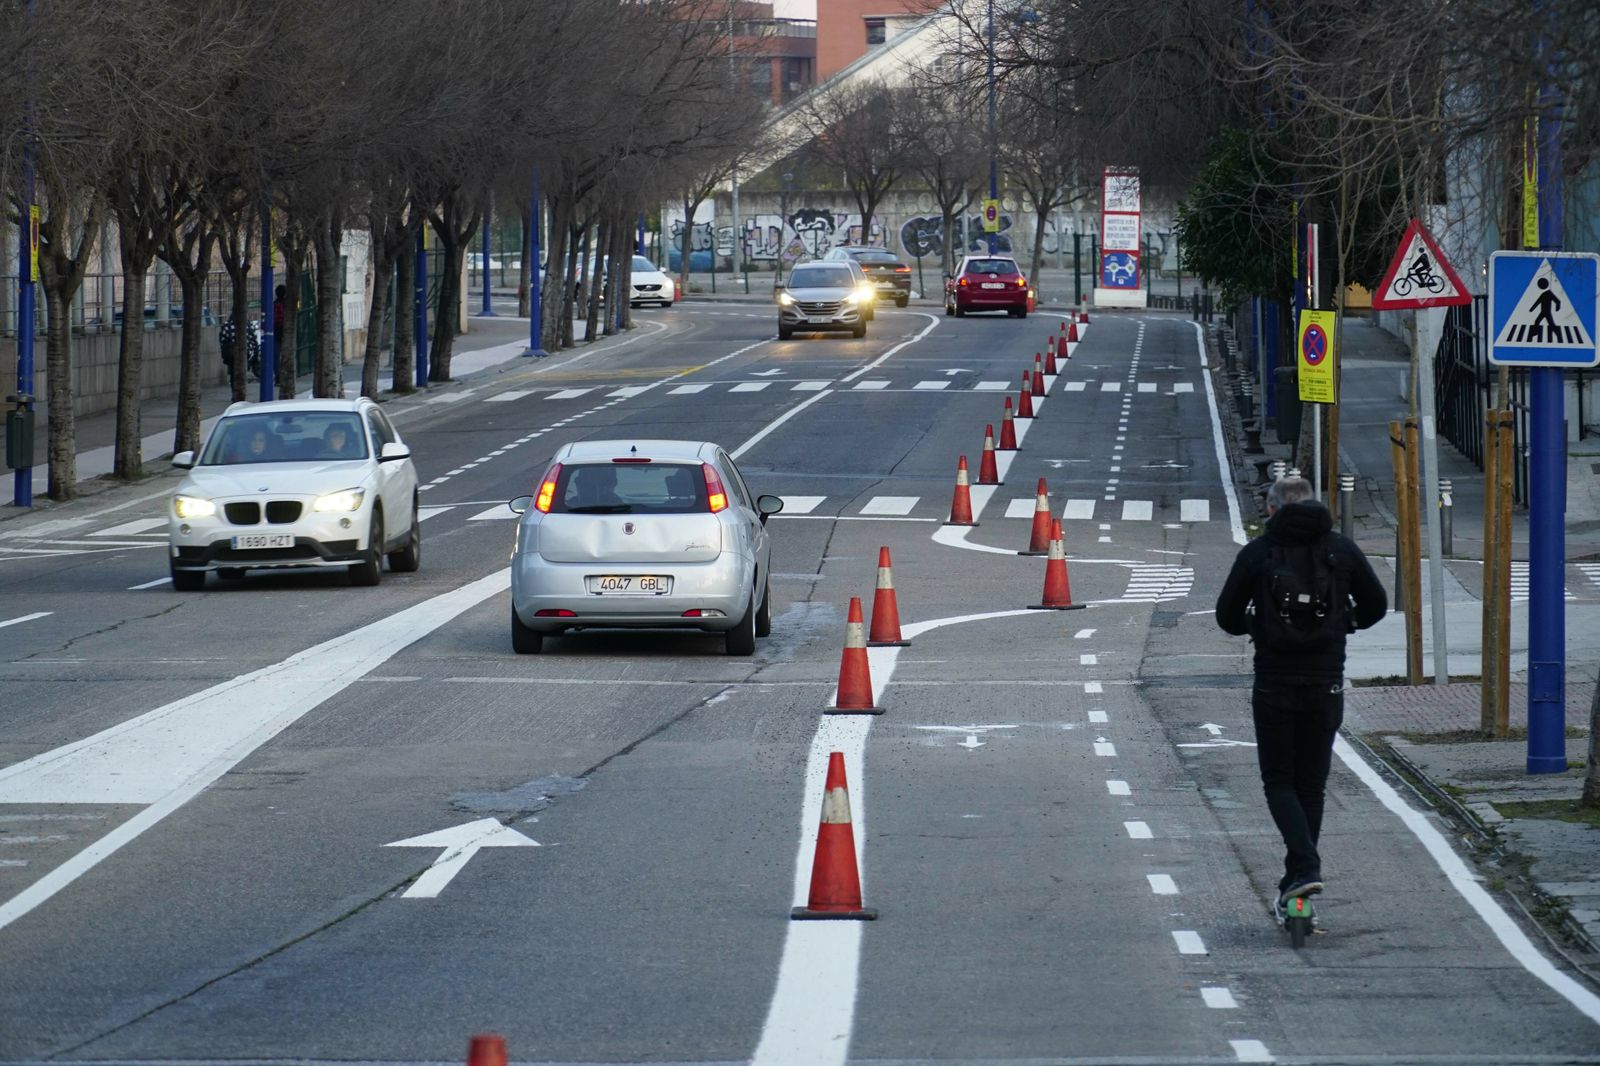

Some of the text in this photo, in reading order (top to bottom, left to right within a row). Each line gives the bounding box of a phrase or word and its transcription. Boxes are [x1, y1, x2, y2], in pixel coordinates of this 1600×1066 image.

[269, 535, 291, 546] HZT
[600, 578, 663, 590] 4047 GBL
